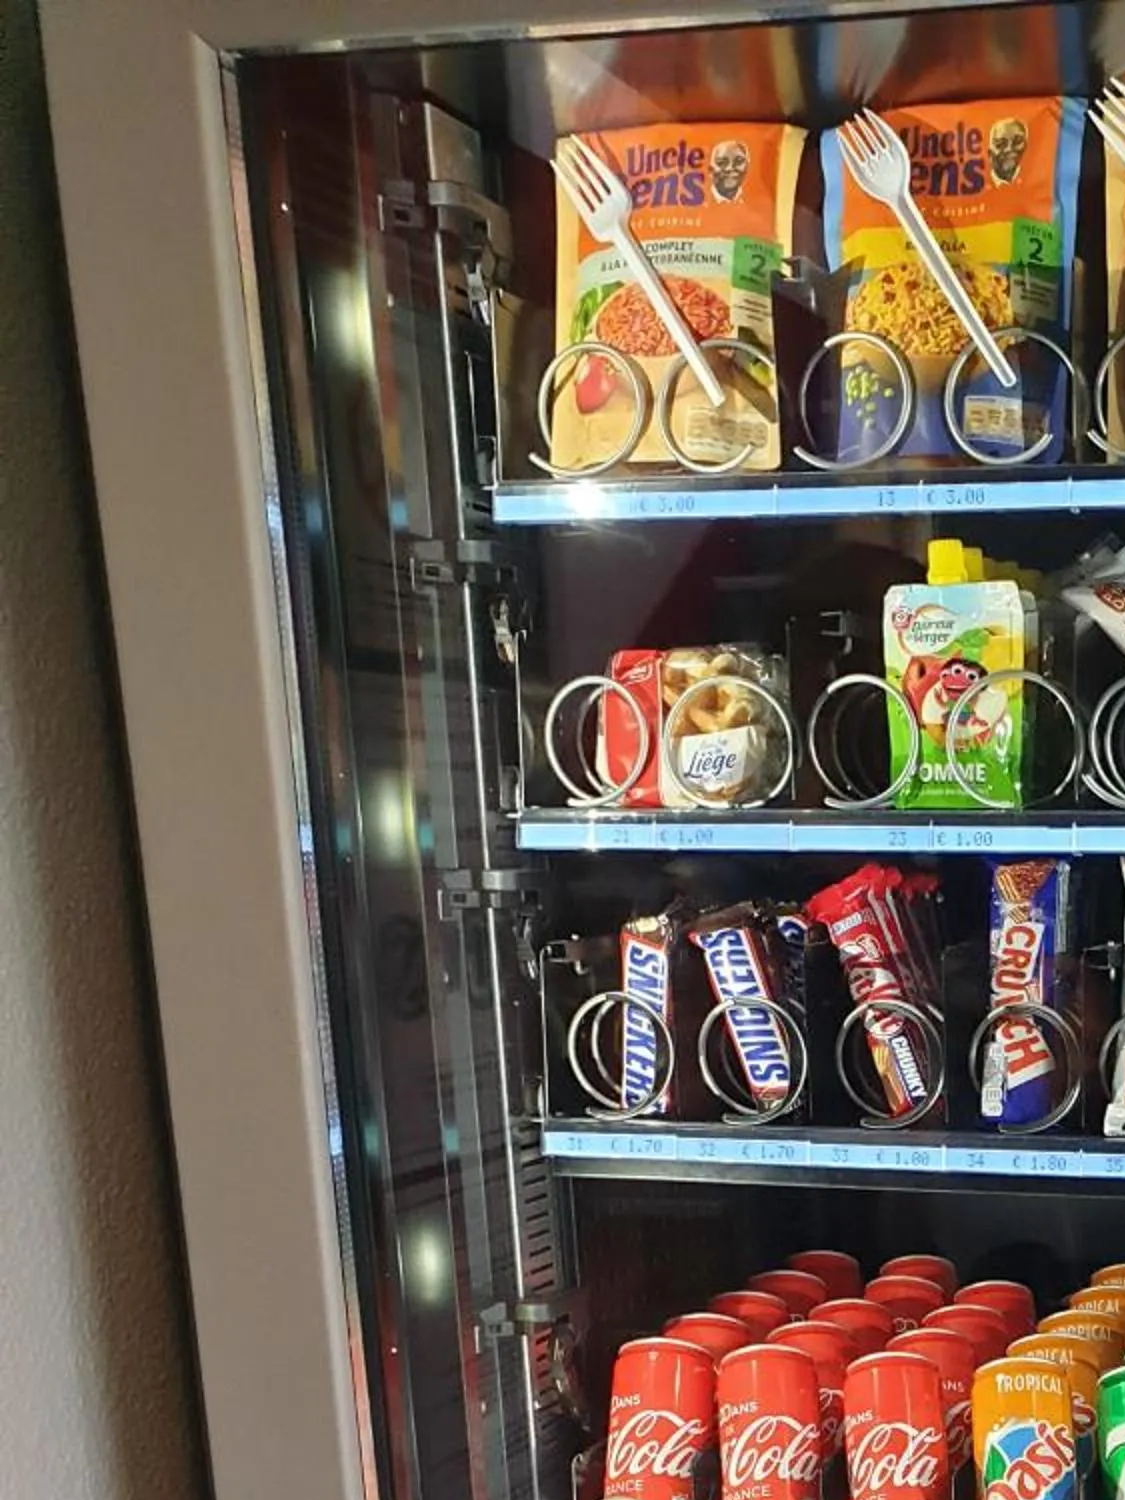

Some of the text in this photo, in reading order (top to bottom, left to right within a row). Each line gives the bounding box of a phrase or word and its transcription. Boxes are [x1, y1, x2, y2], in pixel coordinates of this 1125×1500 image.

[627, 140, 705, 174] Uncle
[1028, 238, 1044, 262] 2
[750, 254, 767, 277] 2
[683, 746, 737, 778] Liège
[956, 831, 993, 847] 1.00
[699, 927, 791, 1085] SNICKERS
[891, 1034, 929, 1098] CHUNKY
[628, 1137, 663, 1153] 1.70
[760, 1142, 795, 1158] 1.70
[967, 1153, 984, 1168] 34
[995, 1373, 1064, 1395] TROPICAL
